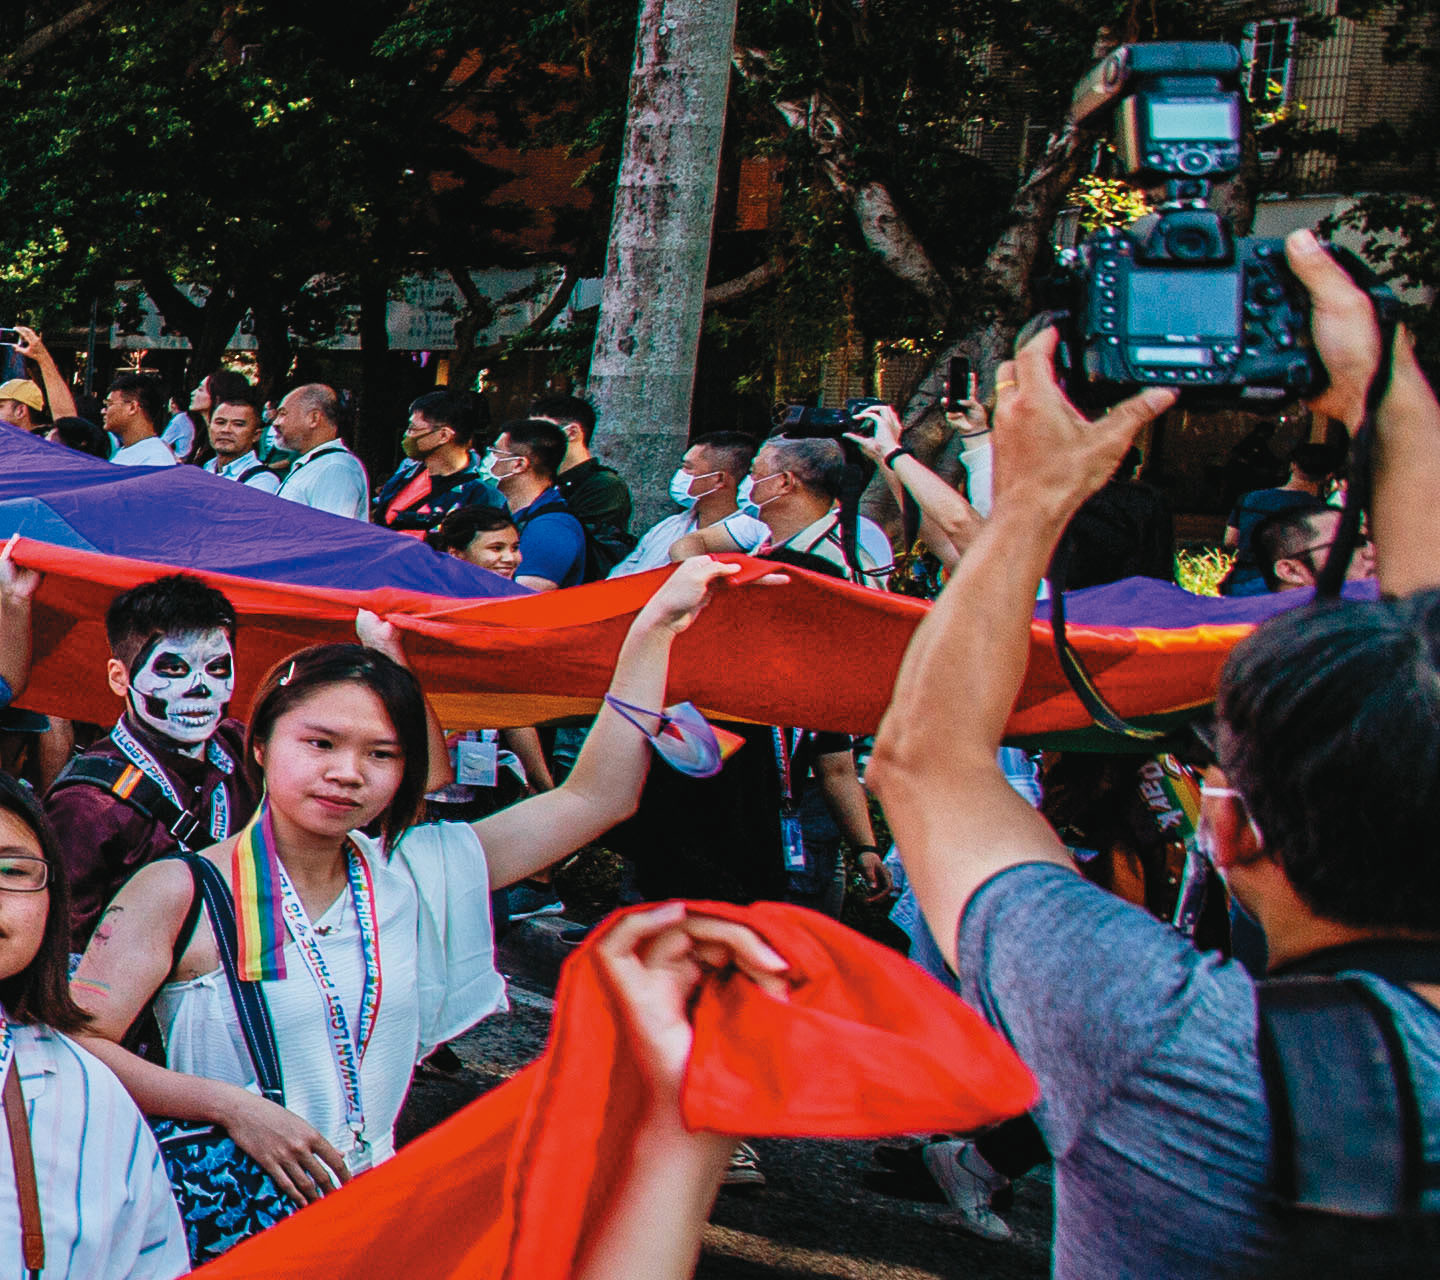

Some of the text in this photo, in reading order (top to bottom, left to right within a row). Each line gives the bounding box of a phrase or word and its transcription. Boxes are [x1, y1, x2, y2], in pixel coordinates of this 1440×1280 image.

[118, 733, 152, 765] LGBT
[214, 805, 227, 839] RIDE
[354, 890, 376, 941] PRIDE
[367, 960, 380, 978] 18
[300, 936, 336, 990] PRIDE
[325, 992, 351, 1040] LGBT
[336, 1043, 361, 1115] TAIWAN
